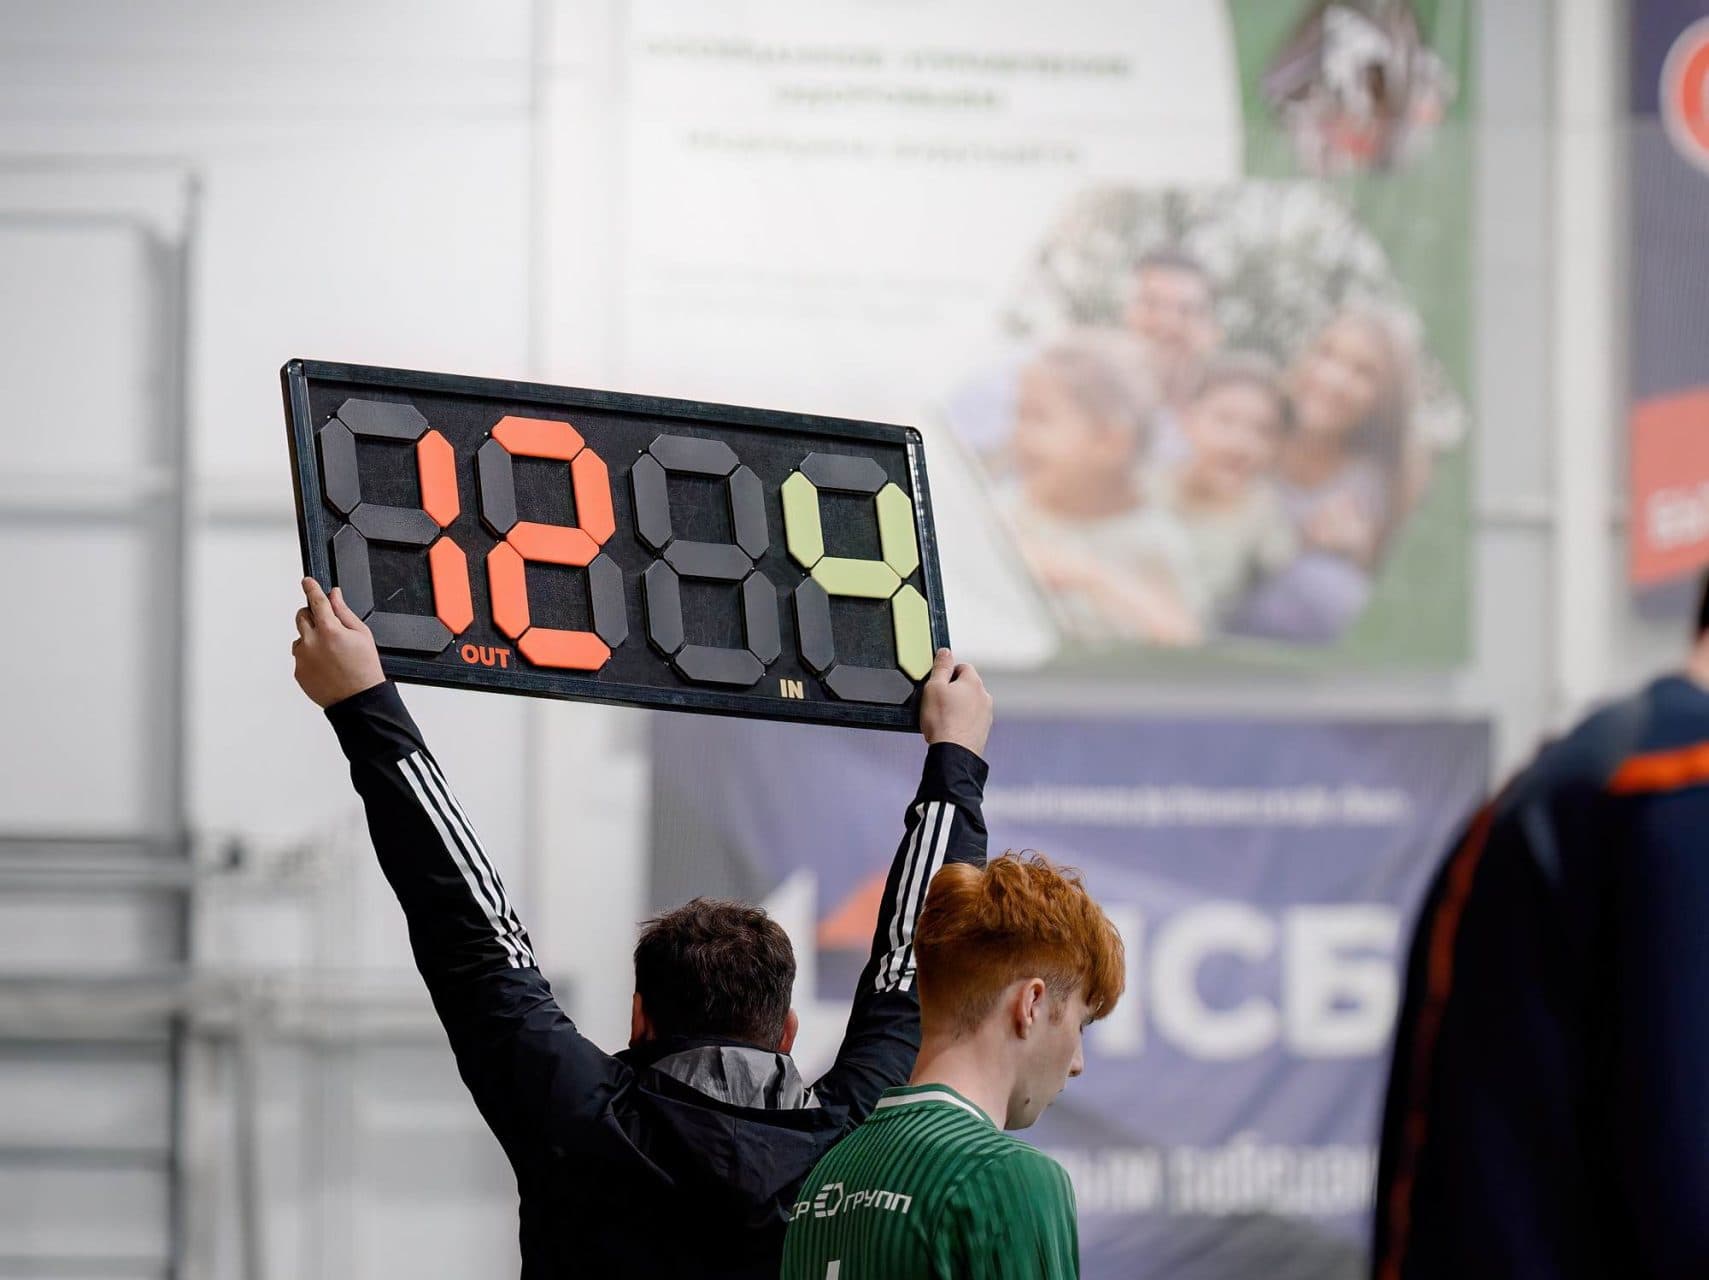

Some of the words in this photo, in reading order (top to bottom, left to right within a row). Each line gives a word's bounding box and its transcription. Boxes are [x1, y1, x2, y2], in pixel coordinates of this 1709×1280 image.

[417, 415, 616, 671] 12
[781, 471, 933, 681] 4
[460, 643, 511, 669] OUT
[779, 677, 804, 700] IN
[843, 1189, 913, 1214] ГРУПП
